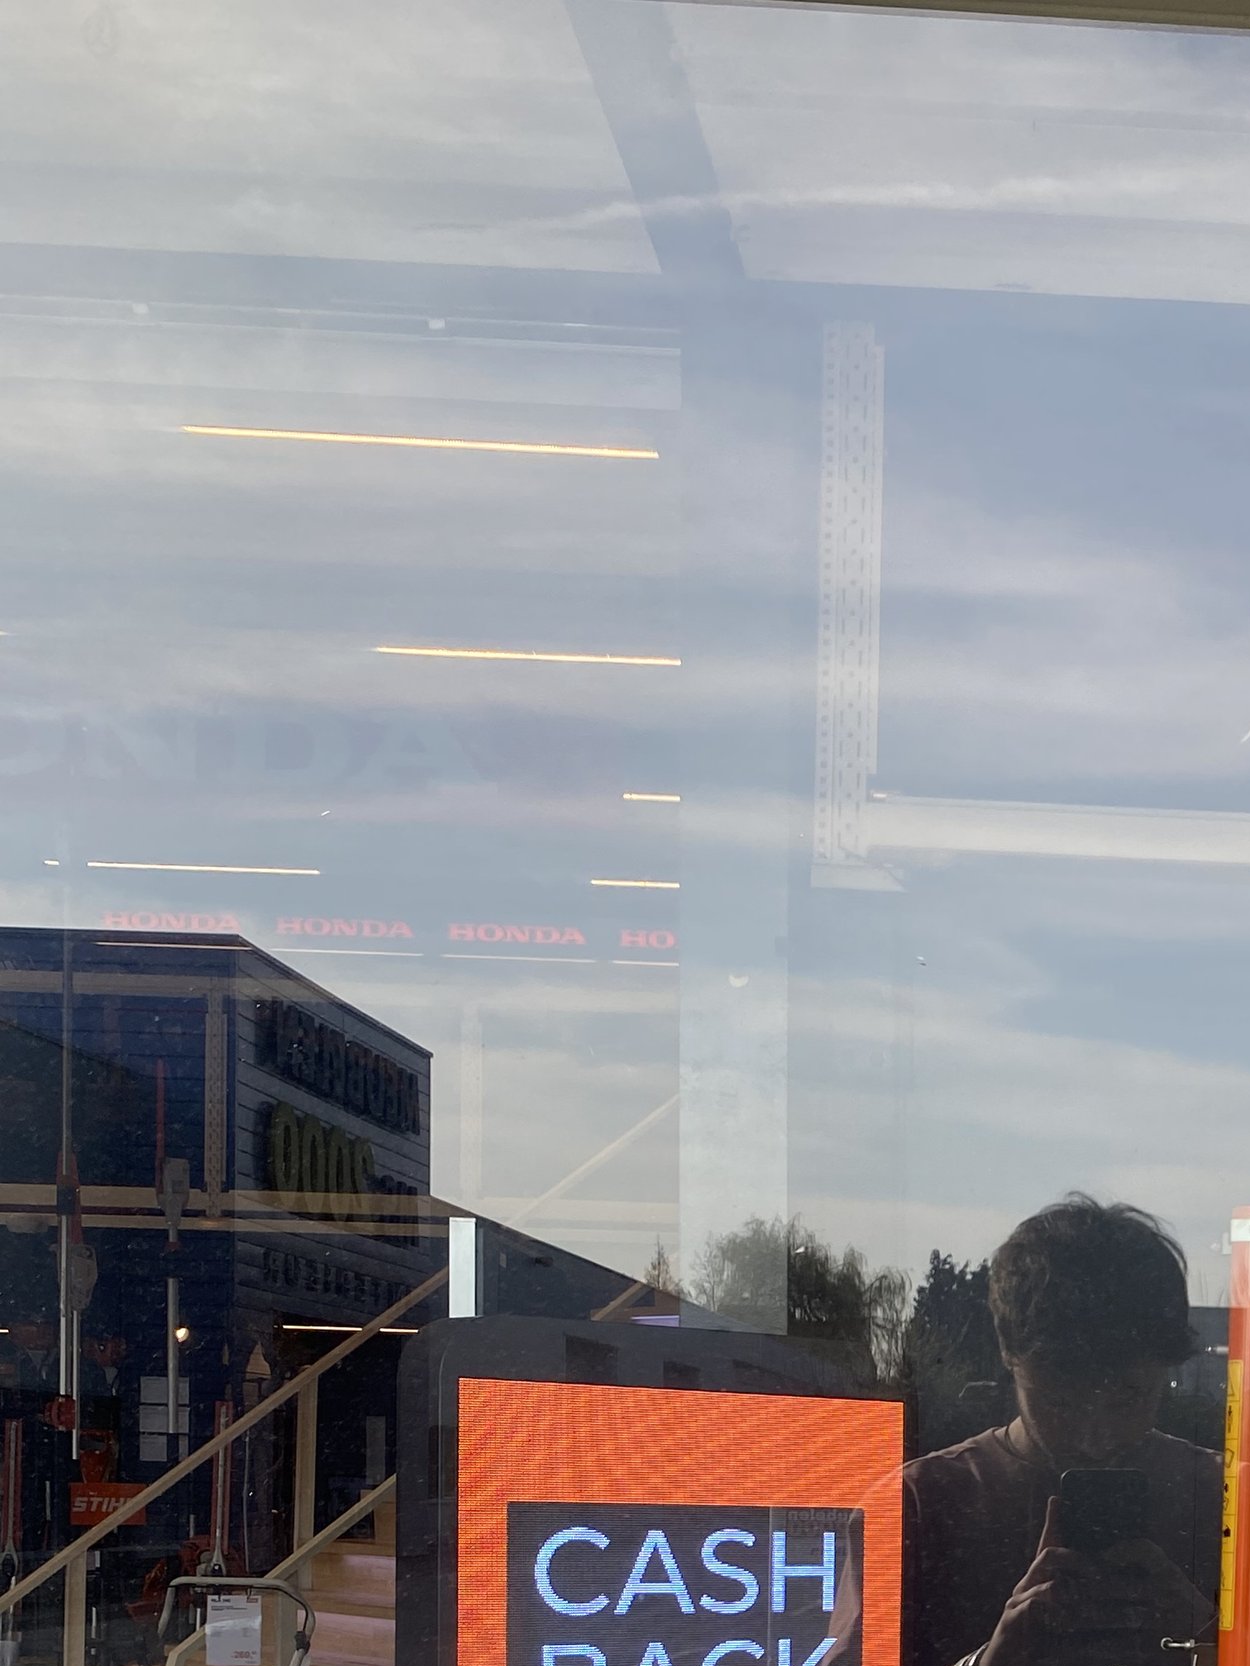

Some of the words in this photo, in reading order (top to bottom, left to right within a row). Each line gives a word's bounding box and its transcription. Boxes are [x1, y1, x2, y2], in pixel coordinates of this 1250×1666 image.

[102, 911, 241, 932] HONDA
[275, 917, 415, 939] HONDA
[447, 922, 587, 946] HONDA
[72, 1497, 135, 1512] STIH
[534, 1527, 836, 1616] CASH
